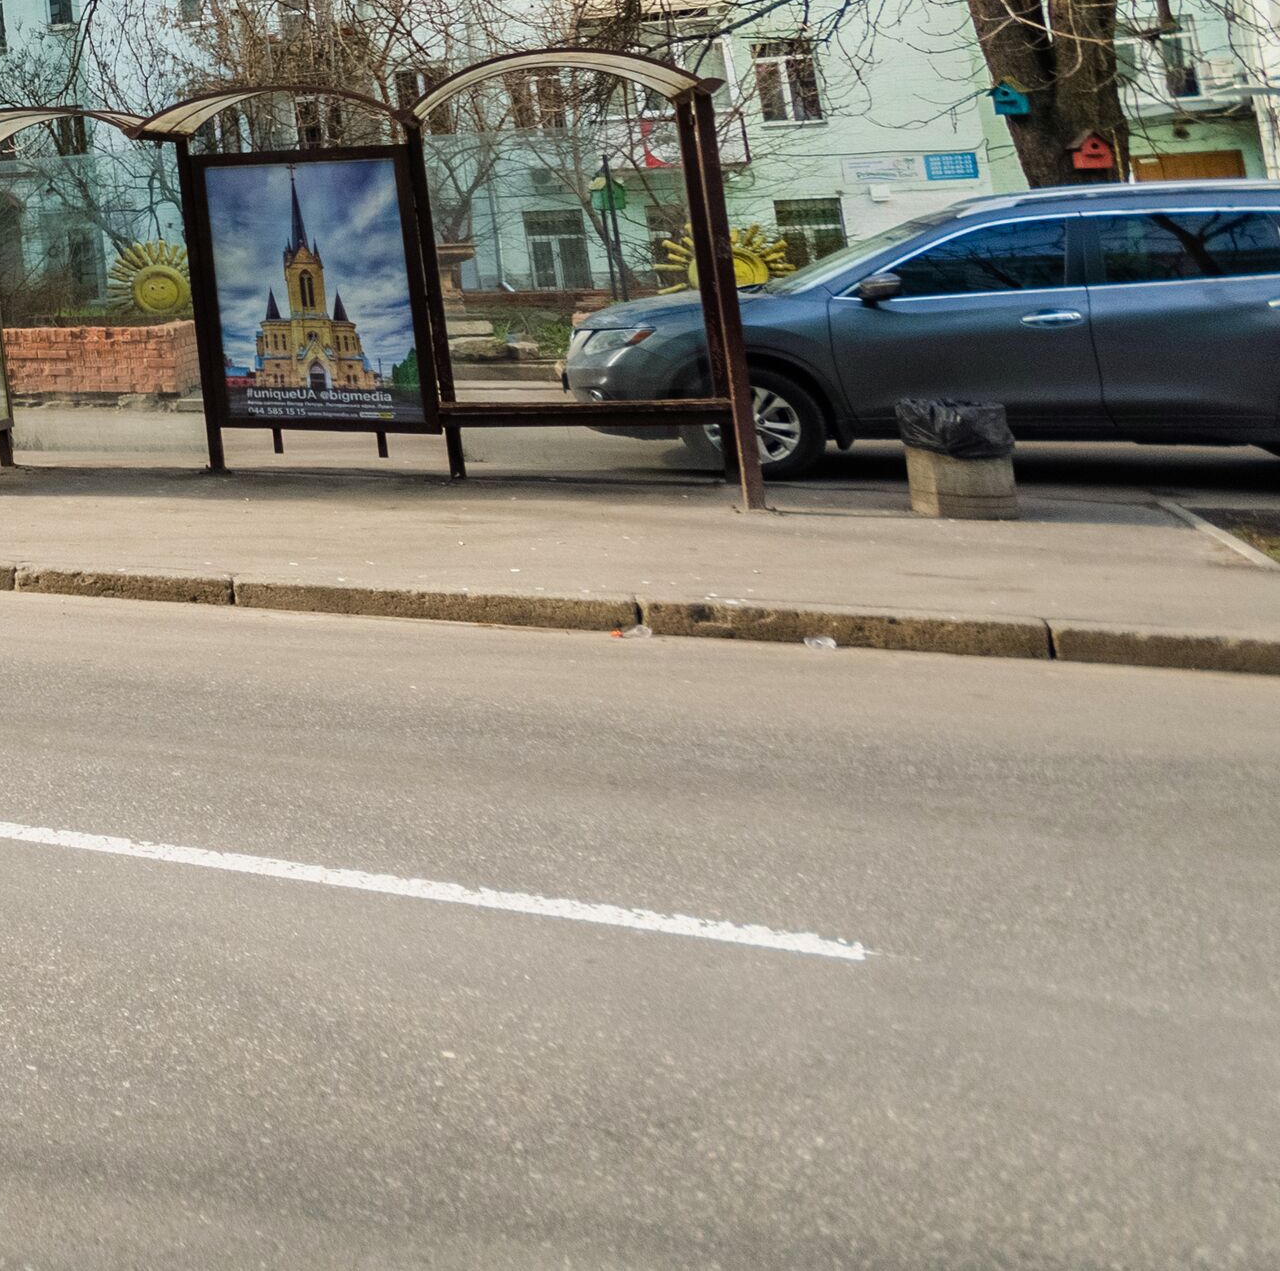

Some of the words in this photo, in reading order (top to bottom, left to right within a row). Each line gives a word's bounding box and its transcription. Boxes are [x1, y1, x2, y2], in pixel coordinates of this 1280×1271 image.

[246, 388, 317, 401] #uniqueUA
[319, 389, 393, 403] @bigmedia
[248, 406, 265, 414] 044
